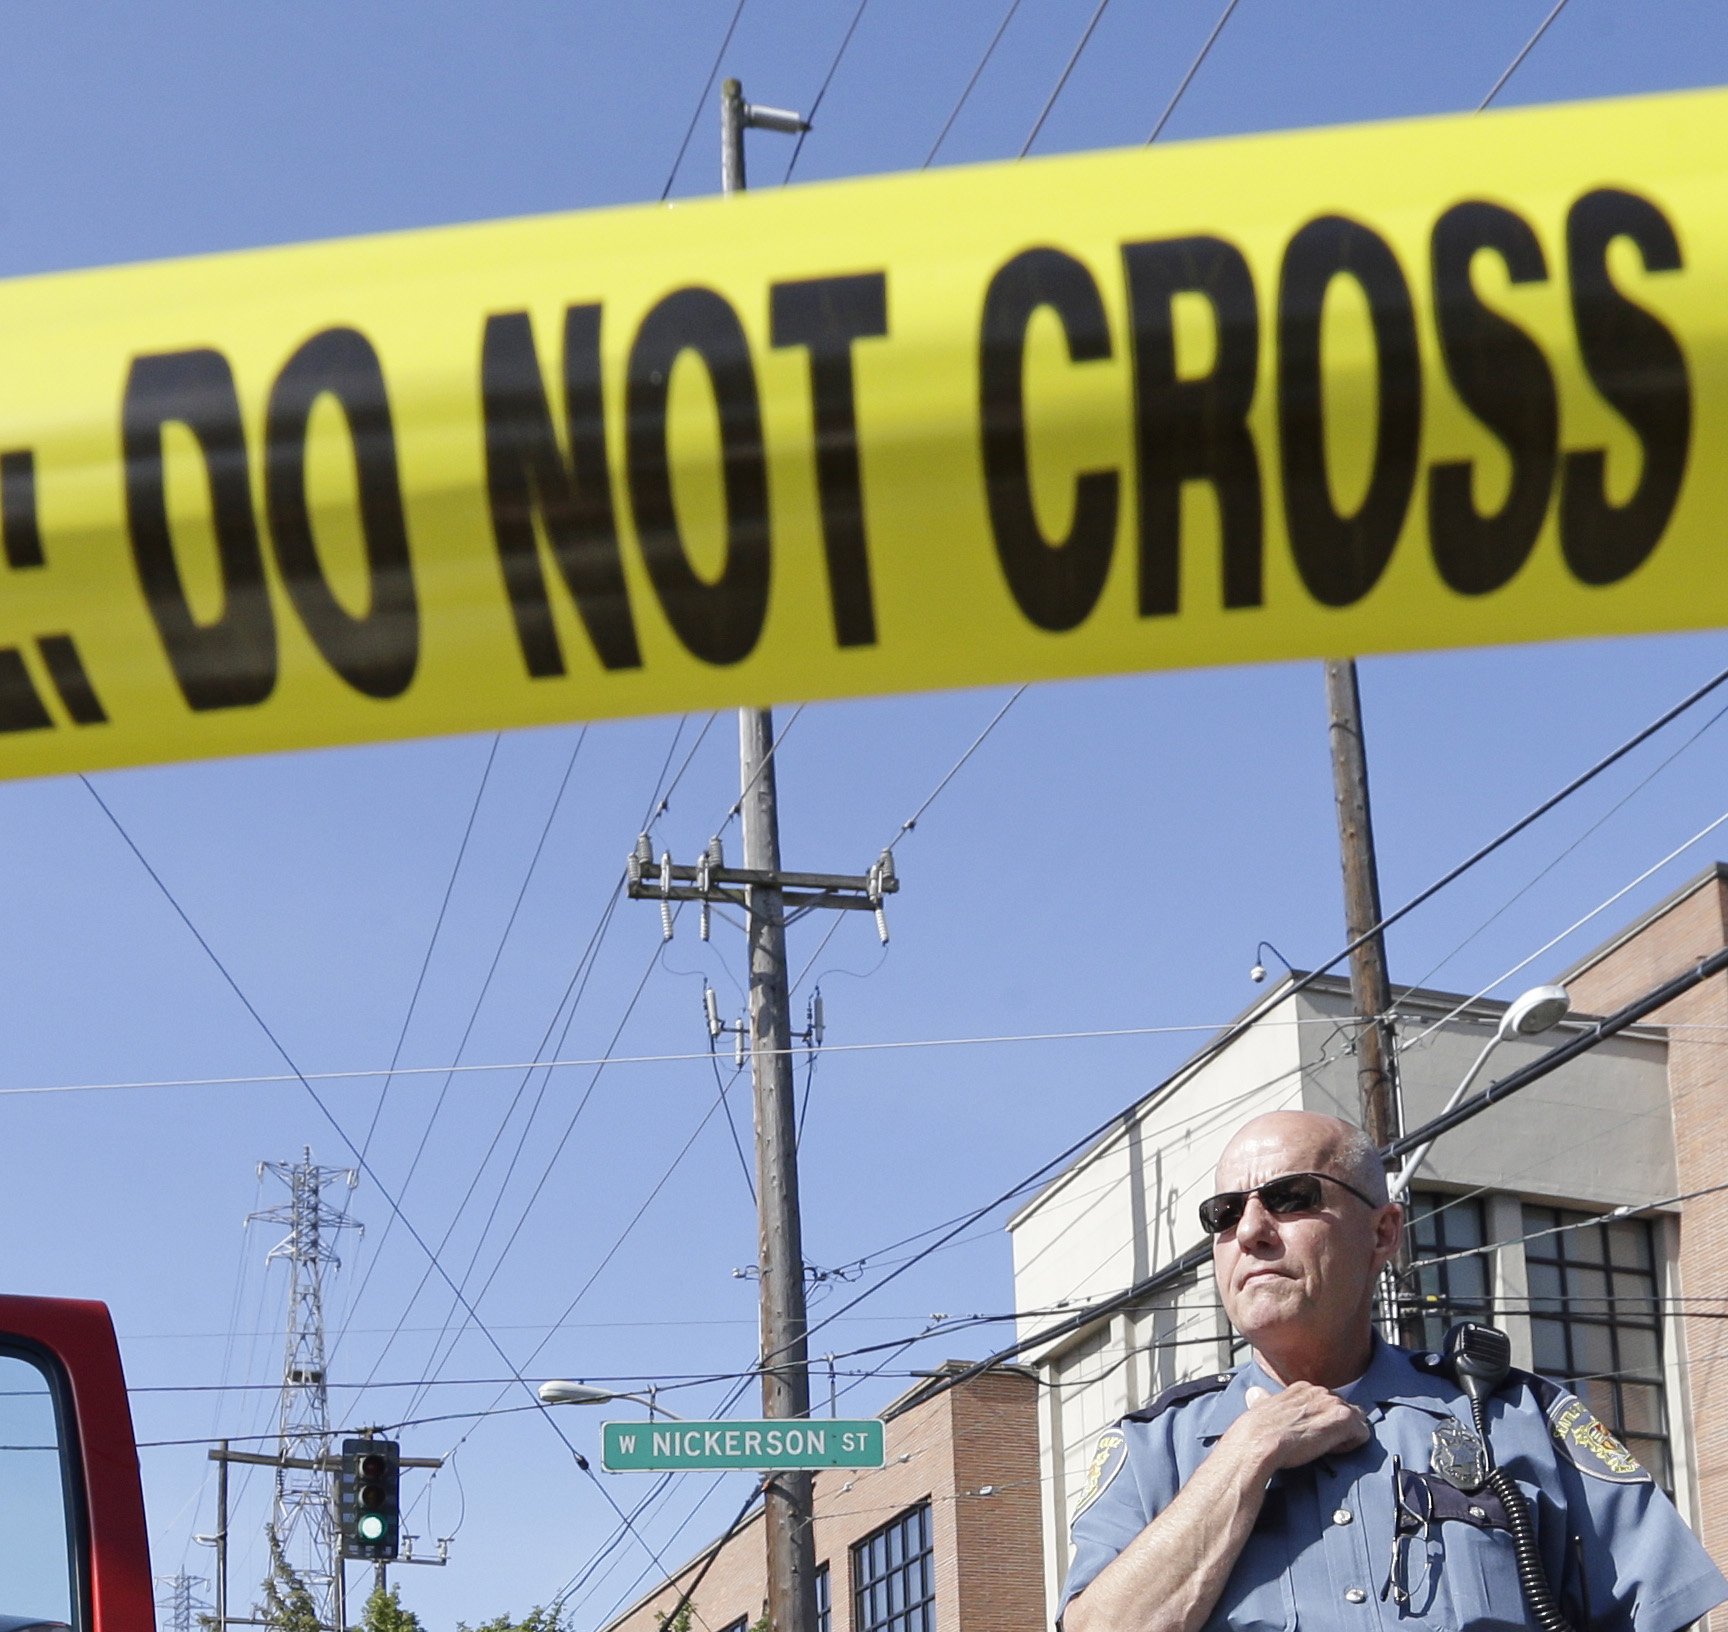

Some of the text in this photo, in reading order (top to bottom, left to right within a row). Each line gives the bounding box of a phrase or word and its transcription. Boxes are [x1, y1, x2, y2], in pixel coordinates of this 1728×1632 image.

[122, 325, 421, 713] DO
[480, 270, 889, 680] NOT
[978, 186, 1693, 635] CROSS
[619, 1430, 869, 1457] W NICKERSON ST
